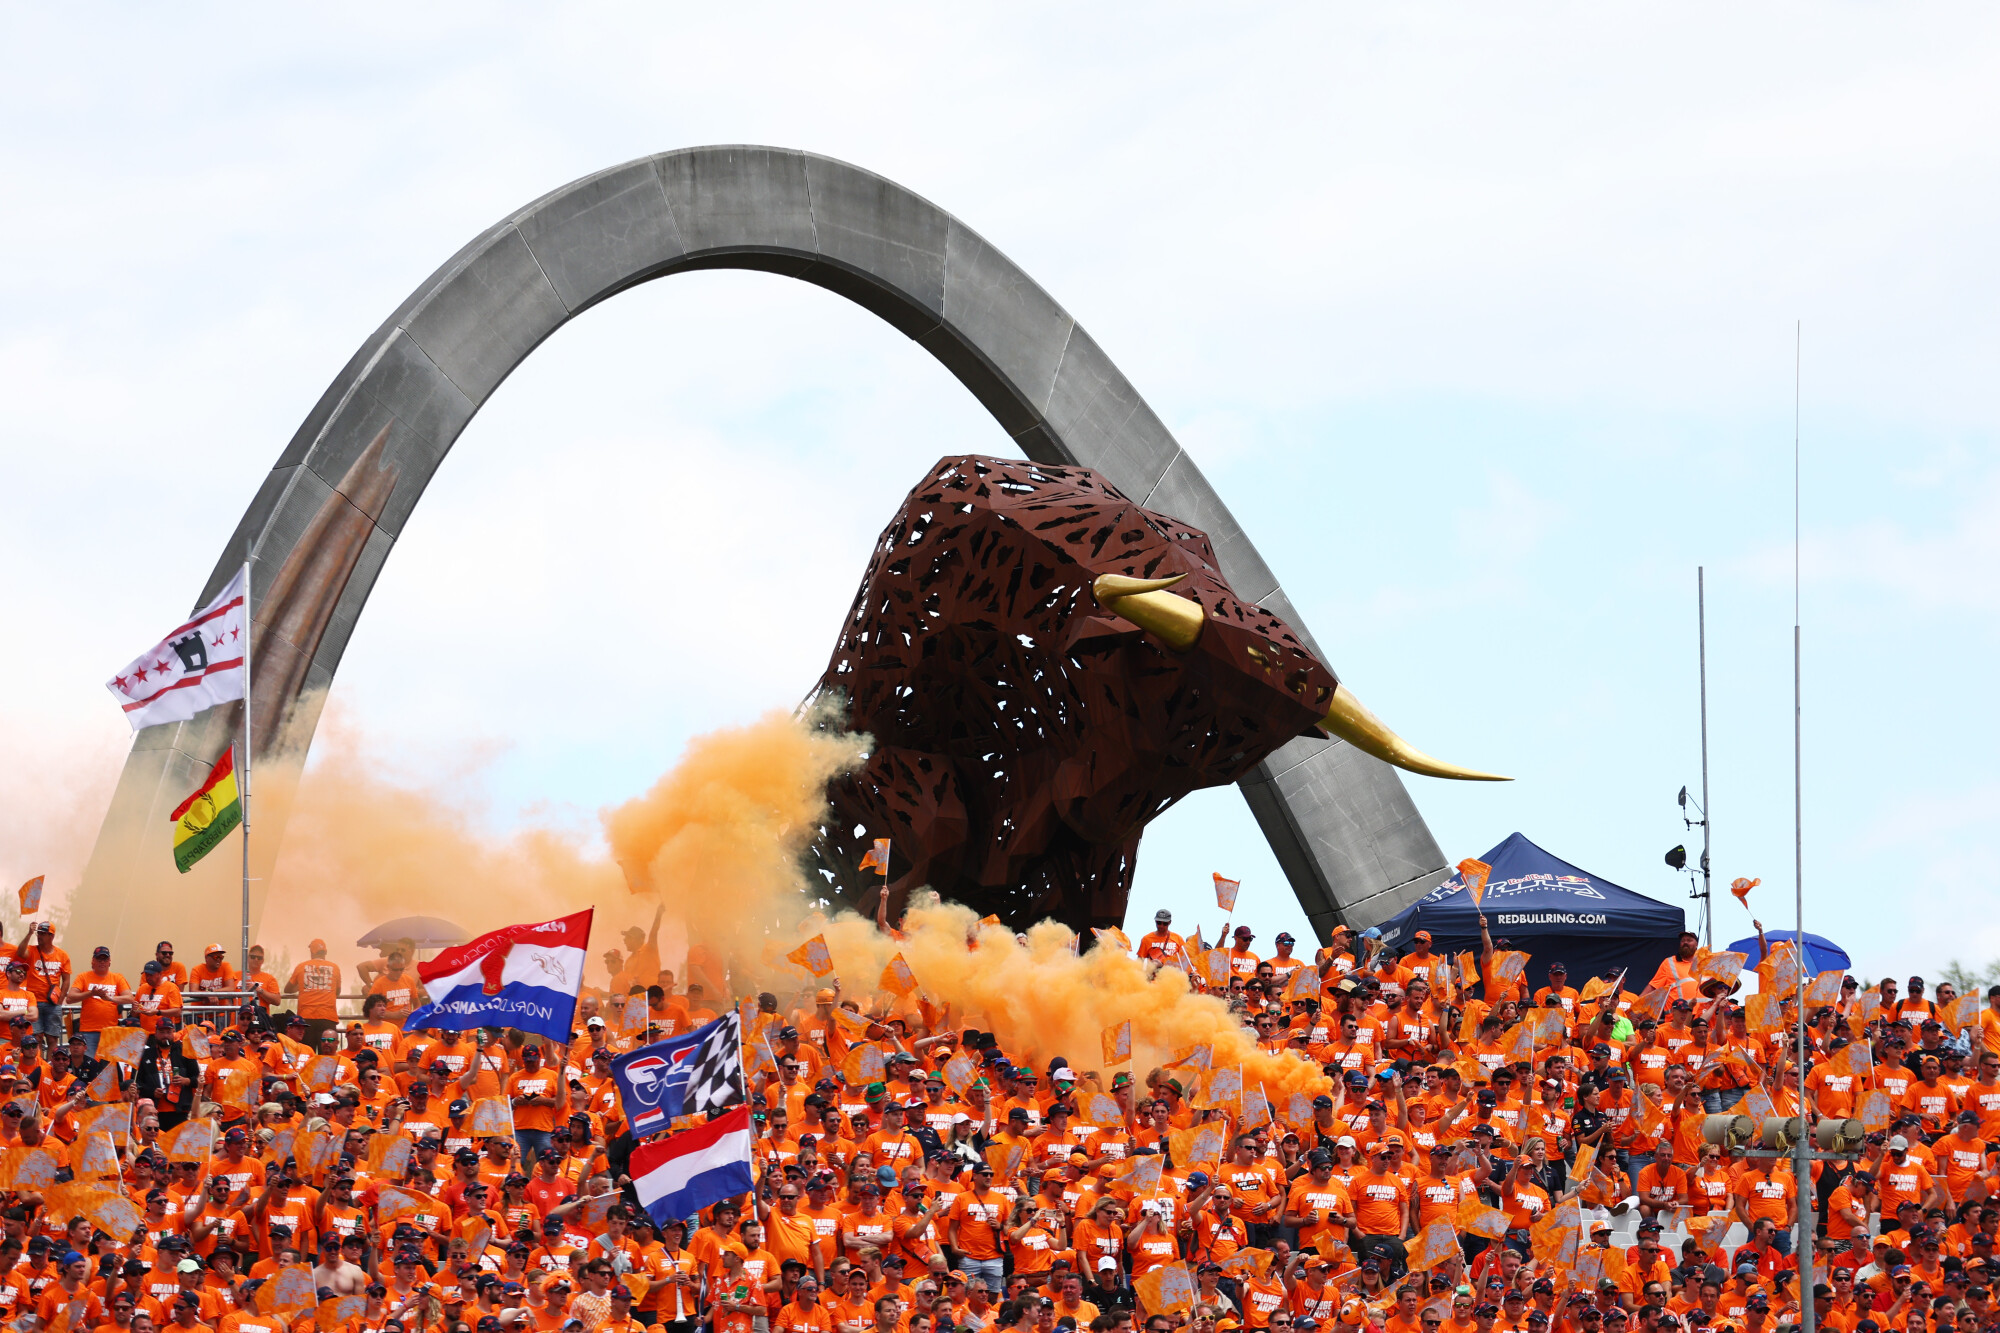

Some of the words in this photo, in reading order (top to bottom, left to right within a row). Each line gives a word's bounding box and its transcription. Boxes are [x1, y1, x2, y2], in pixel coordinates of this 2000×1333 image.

[1507, 875, 1530, 886] Red
[1530, 873, 1553, 881] Bull
[1498, 913, 1607, 925] REDBULLRING.COM
[35, 960, 61, 969] OANGE
[386, 988, 410, 999] ORANGE
[2, 998, 28, 1006] ORANGE
[140, 994, 164, 1002] ORGE
[1901, 1011, 1929, 1019] ORANGE
[810, 1030, 824, 1038] ORA
[1356, 1028, 1374, 1036] ANGE
[365, 1034, 393, 1042] ORANGE
[480, 1055, 501, 1063] RANGE
[447, 1064, 464, 1072] RMY
[1825, 1075, 1852, 1083] ORANGE
[518, 1080, 548, 1088] ORANGE
[1921, 1097, 1947, 1105] ORANGE
[1979, 1094, 2000, 1104] ORAN
[1927, 1105, 1945, 1113] ARMY
[926, 1114, 953, 1122] ORANGE
[1542, 1114, 1565, 1127] ORNGE
[881, 1142, 910, 1150] ORANGE
[1048, 1144, 1074, 1152] ORANG
[1953, 1150, 1979, 1159] ORANGE
[226, 1173, 253, 1182] RANGE
[1232, 1172, 1264, 1184] MAX
[1890, 1174, 1917, 1183] ORANGE
[1367, 1185, 1396, 1194] ORANGE
[1426, 1187, 1455, 1195] ORANGE
[1895, 1183, 1916, 1191] ARMY
[1063, 1191, 1082, 1199] ORAN
[1762, 1190, 1784, 1198] ARMY
[1432, 1195, 1454, 1203] ARMY
[968, 1204, 999, 1213] ORANGE
[1313, 1201, 1336, 1209] ARMY
[205, 1216, 236, 1226] ORNGE
[333, 1217, 357, 1226] ORANG
[743, 1261, 765, 1269] ANGE
[151, 1284, 180, 1293] ORANG
[1253, 1292, 1281, 1302] ORANGE
[1729, 1307, 1747, 1315] ORA
